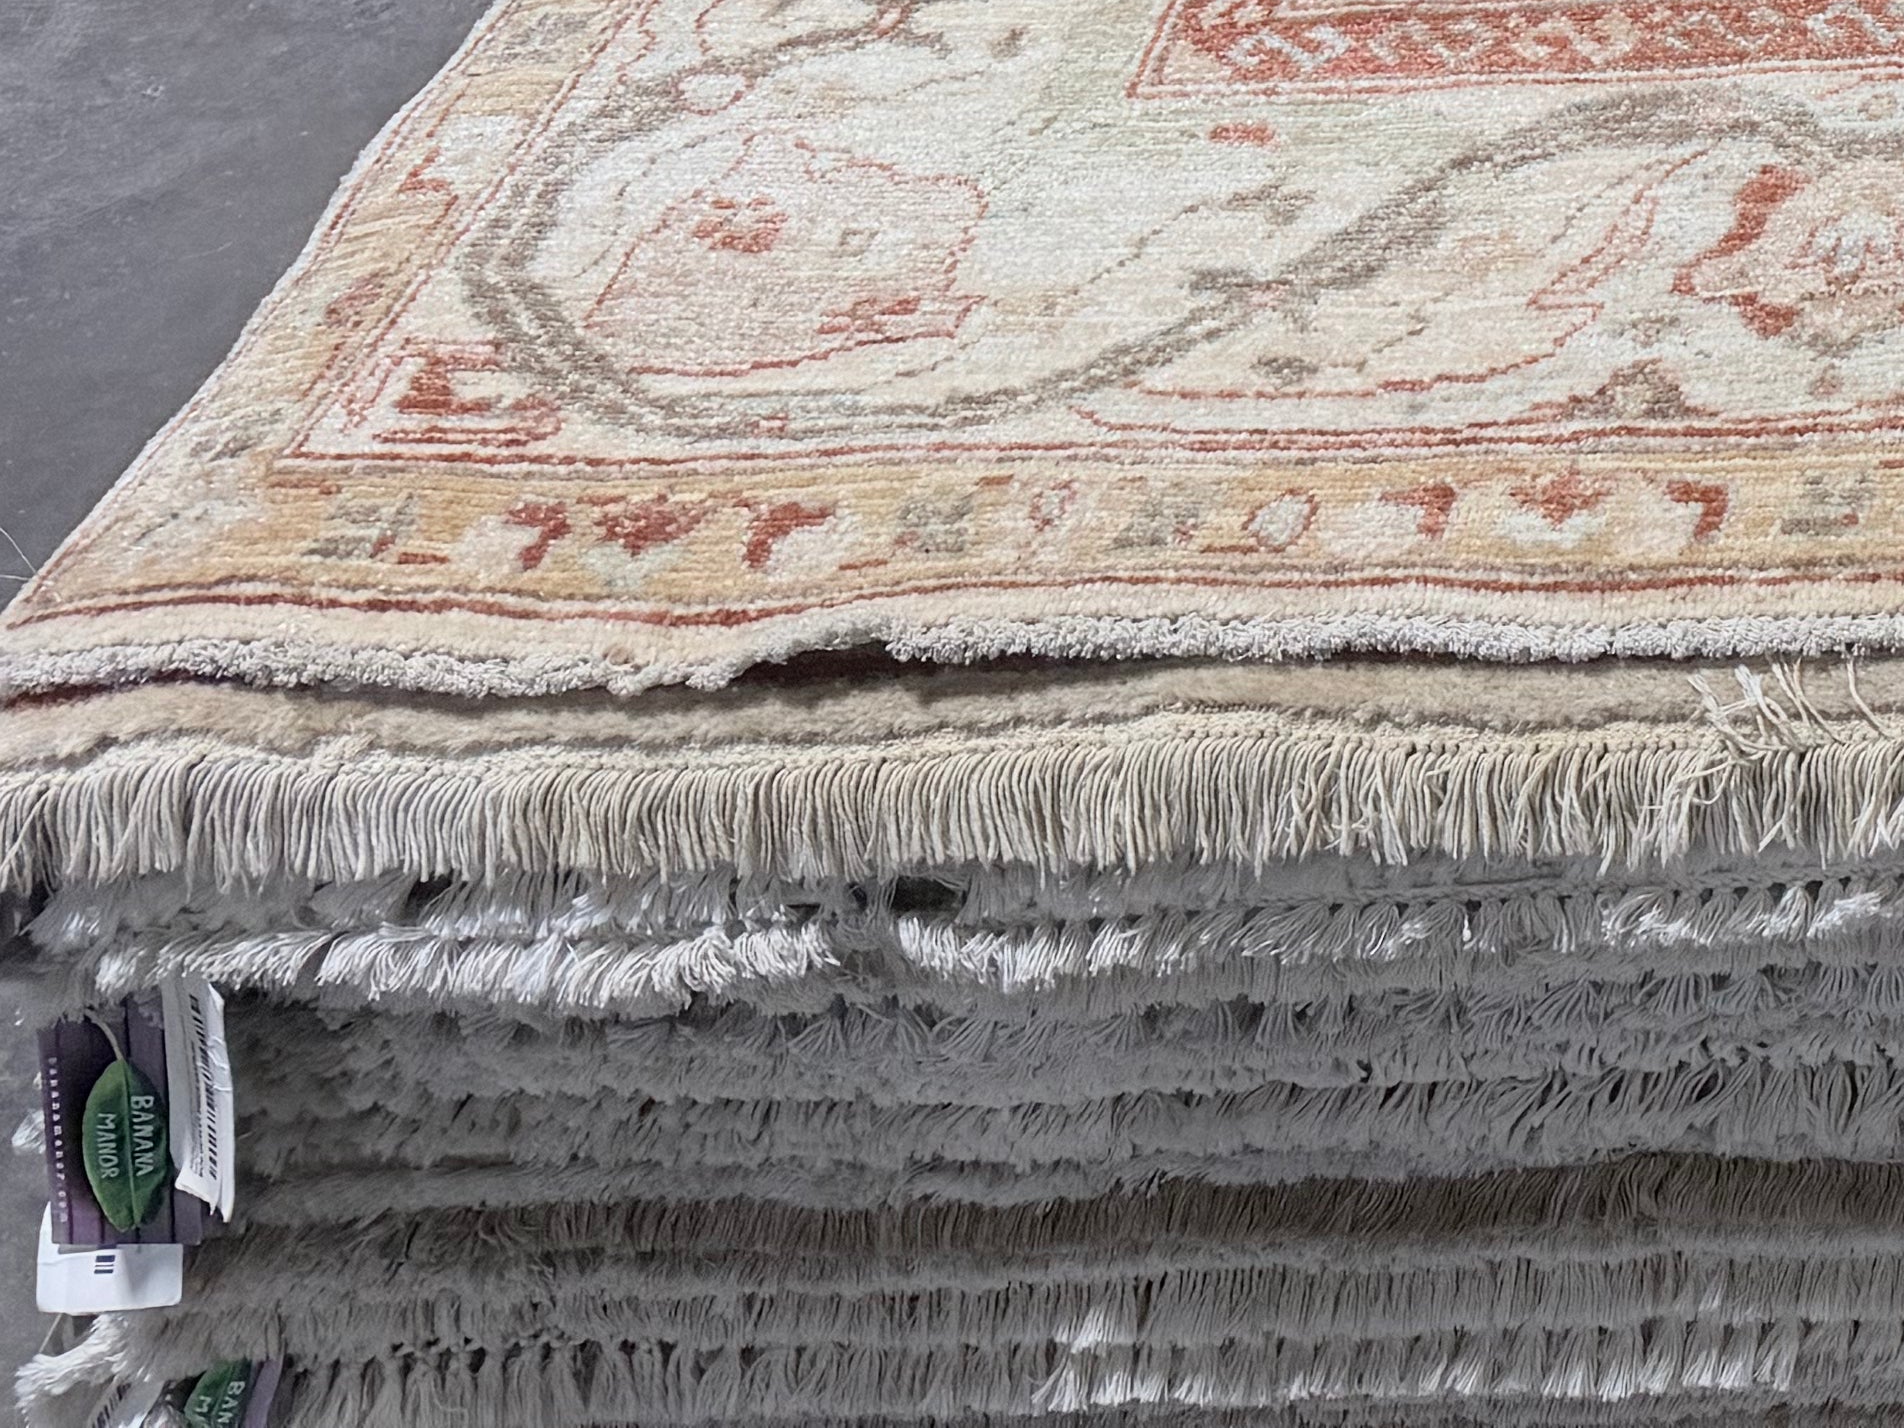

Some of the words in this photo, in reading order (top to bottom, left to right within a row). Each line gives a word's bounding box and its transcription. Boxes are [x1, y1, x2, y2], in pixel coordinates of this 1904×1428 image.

[96, 1112, 121, 1180] MANOR
[130, 1095, 155, 1177] BANANA
[217, 1380, 246, 1428] BAN
